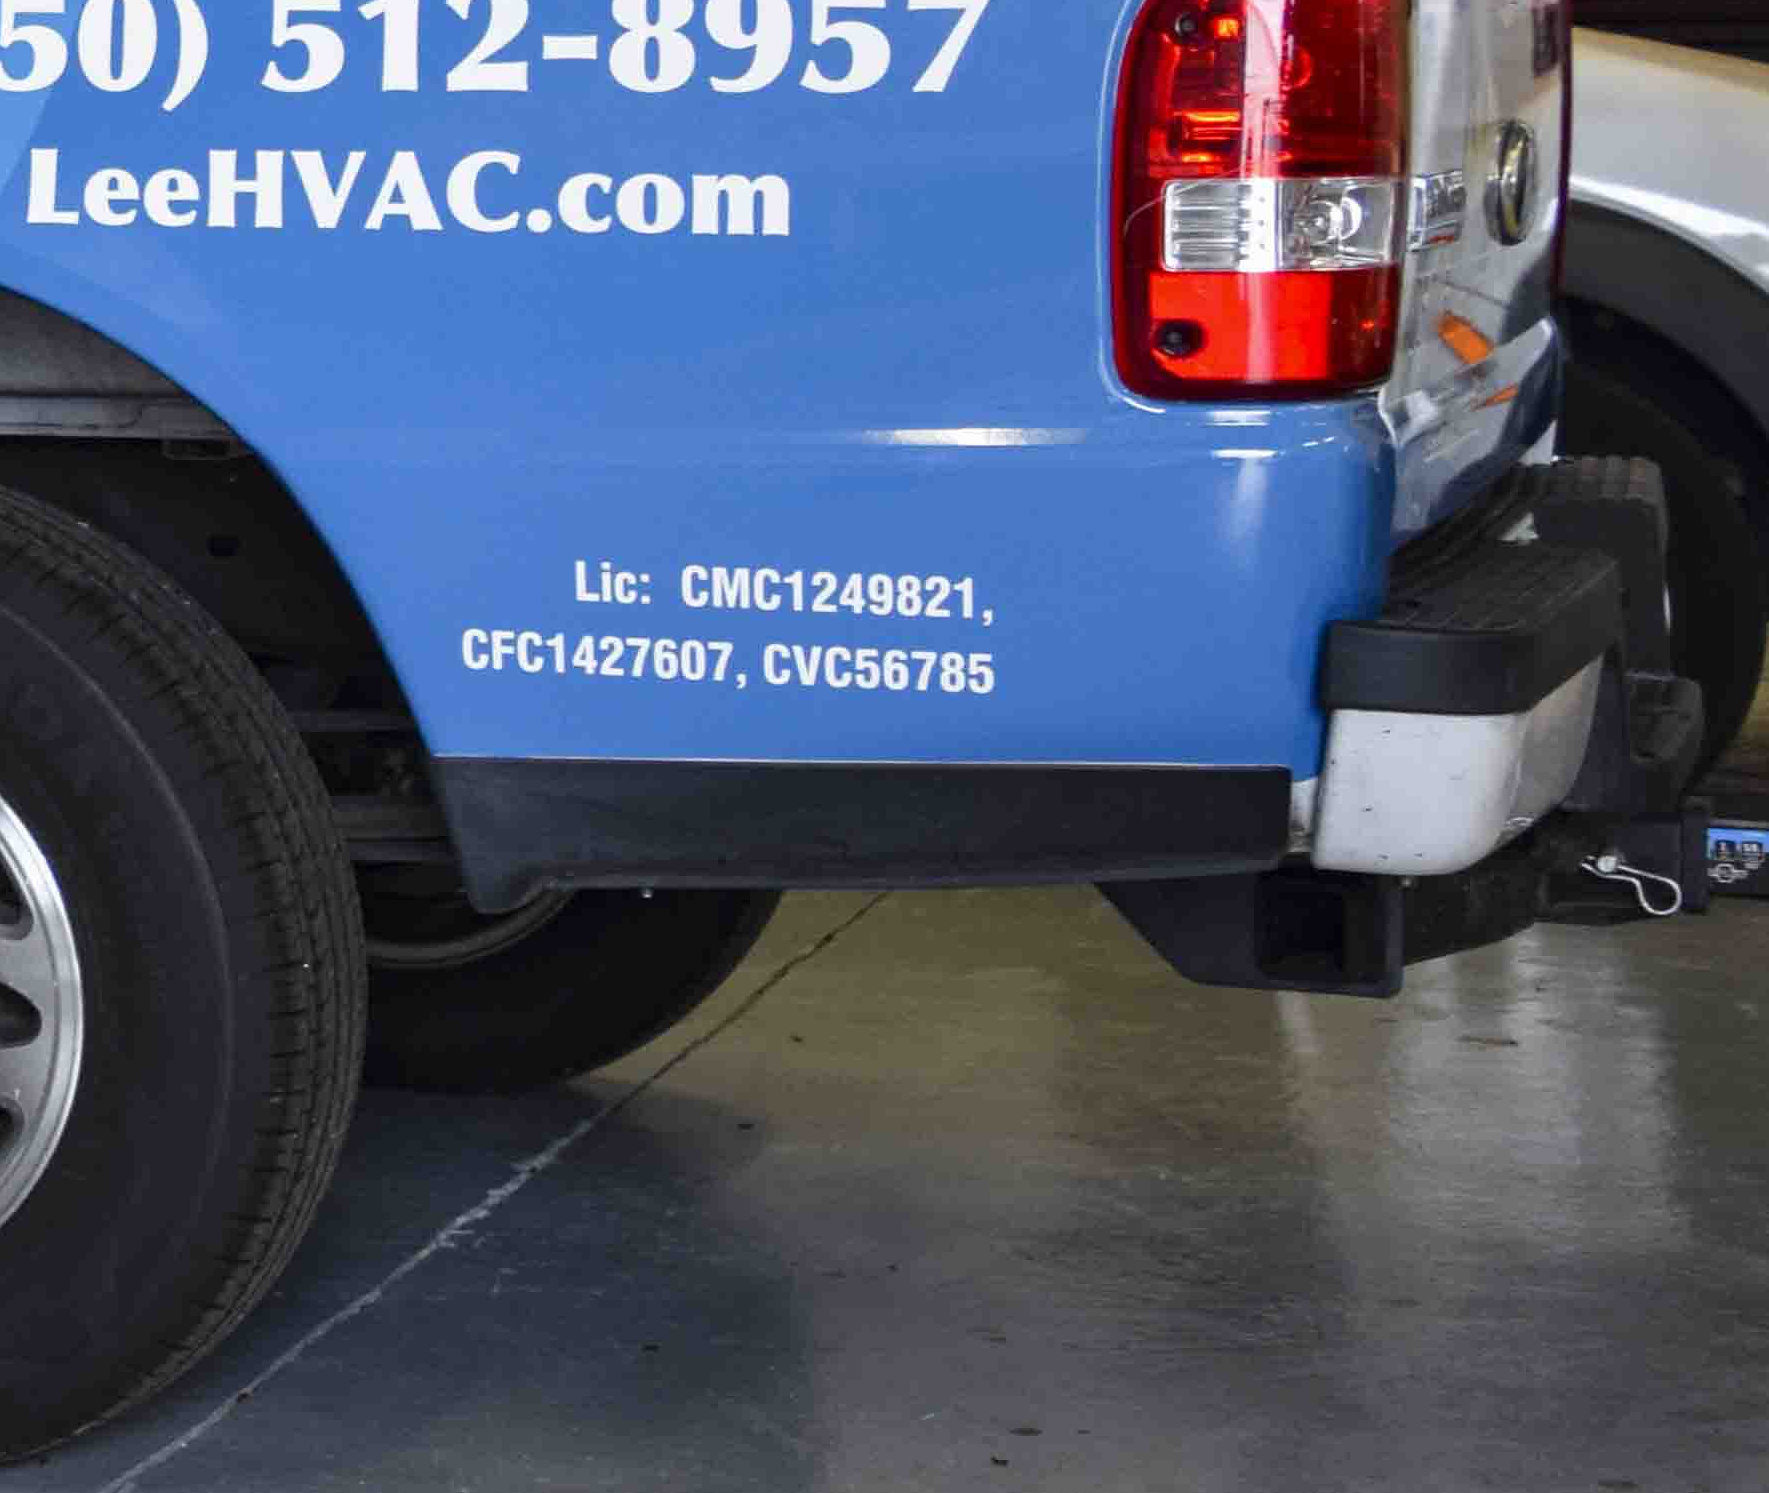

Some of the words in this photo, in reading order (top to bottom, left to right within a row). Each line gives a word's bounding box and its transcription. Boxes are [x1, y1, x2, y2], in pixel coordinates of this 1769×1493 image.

[25, 149, 792, 237] LeeHVAC.com
[574, 559, 652, 605] Lic:
[680, 564, 995, 628] CMC1249821,
[461, 627, 747, 690] CFC1427607,
[762, 643, 996, 695] CVC56785
